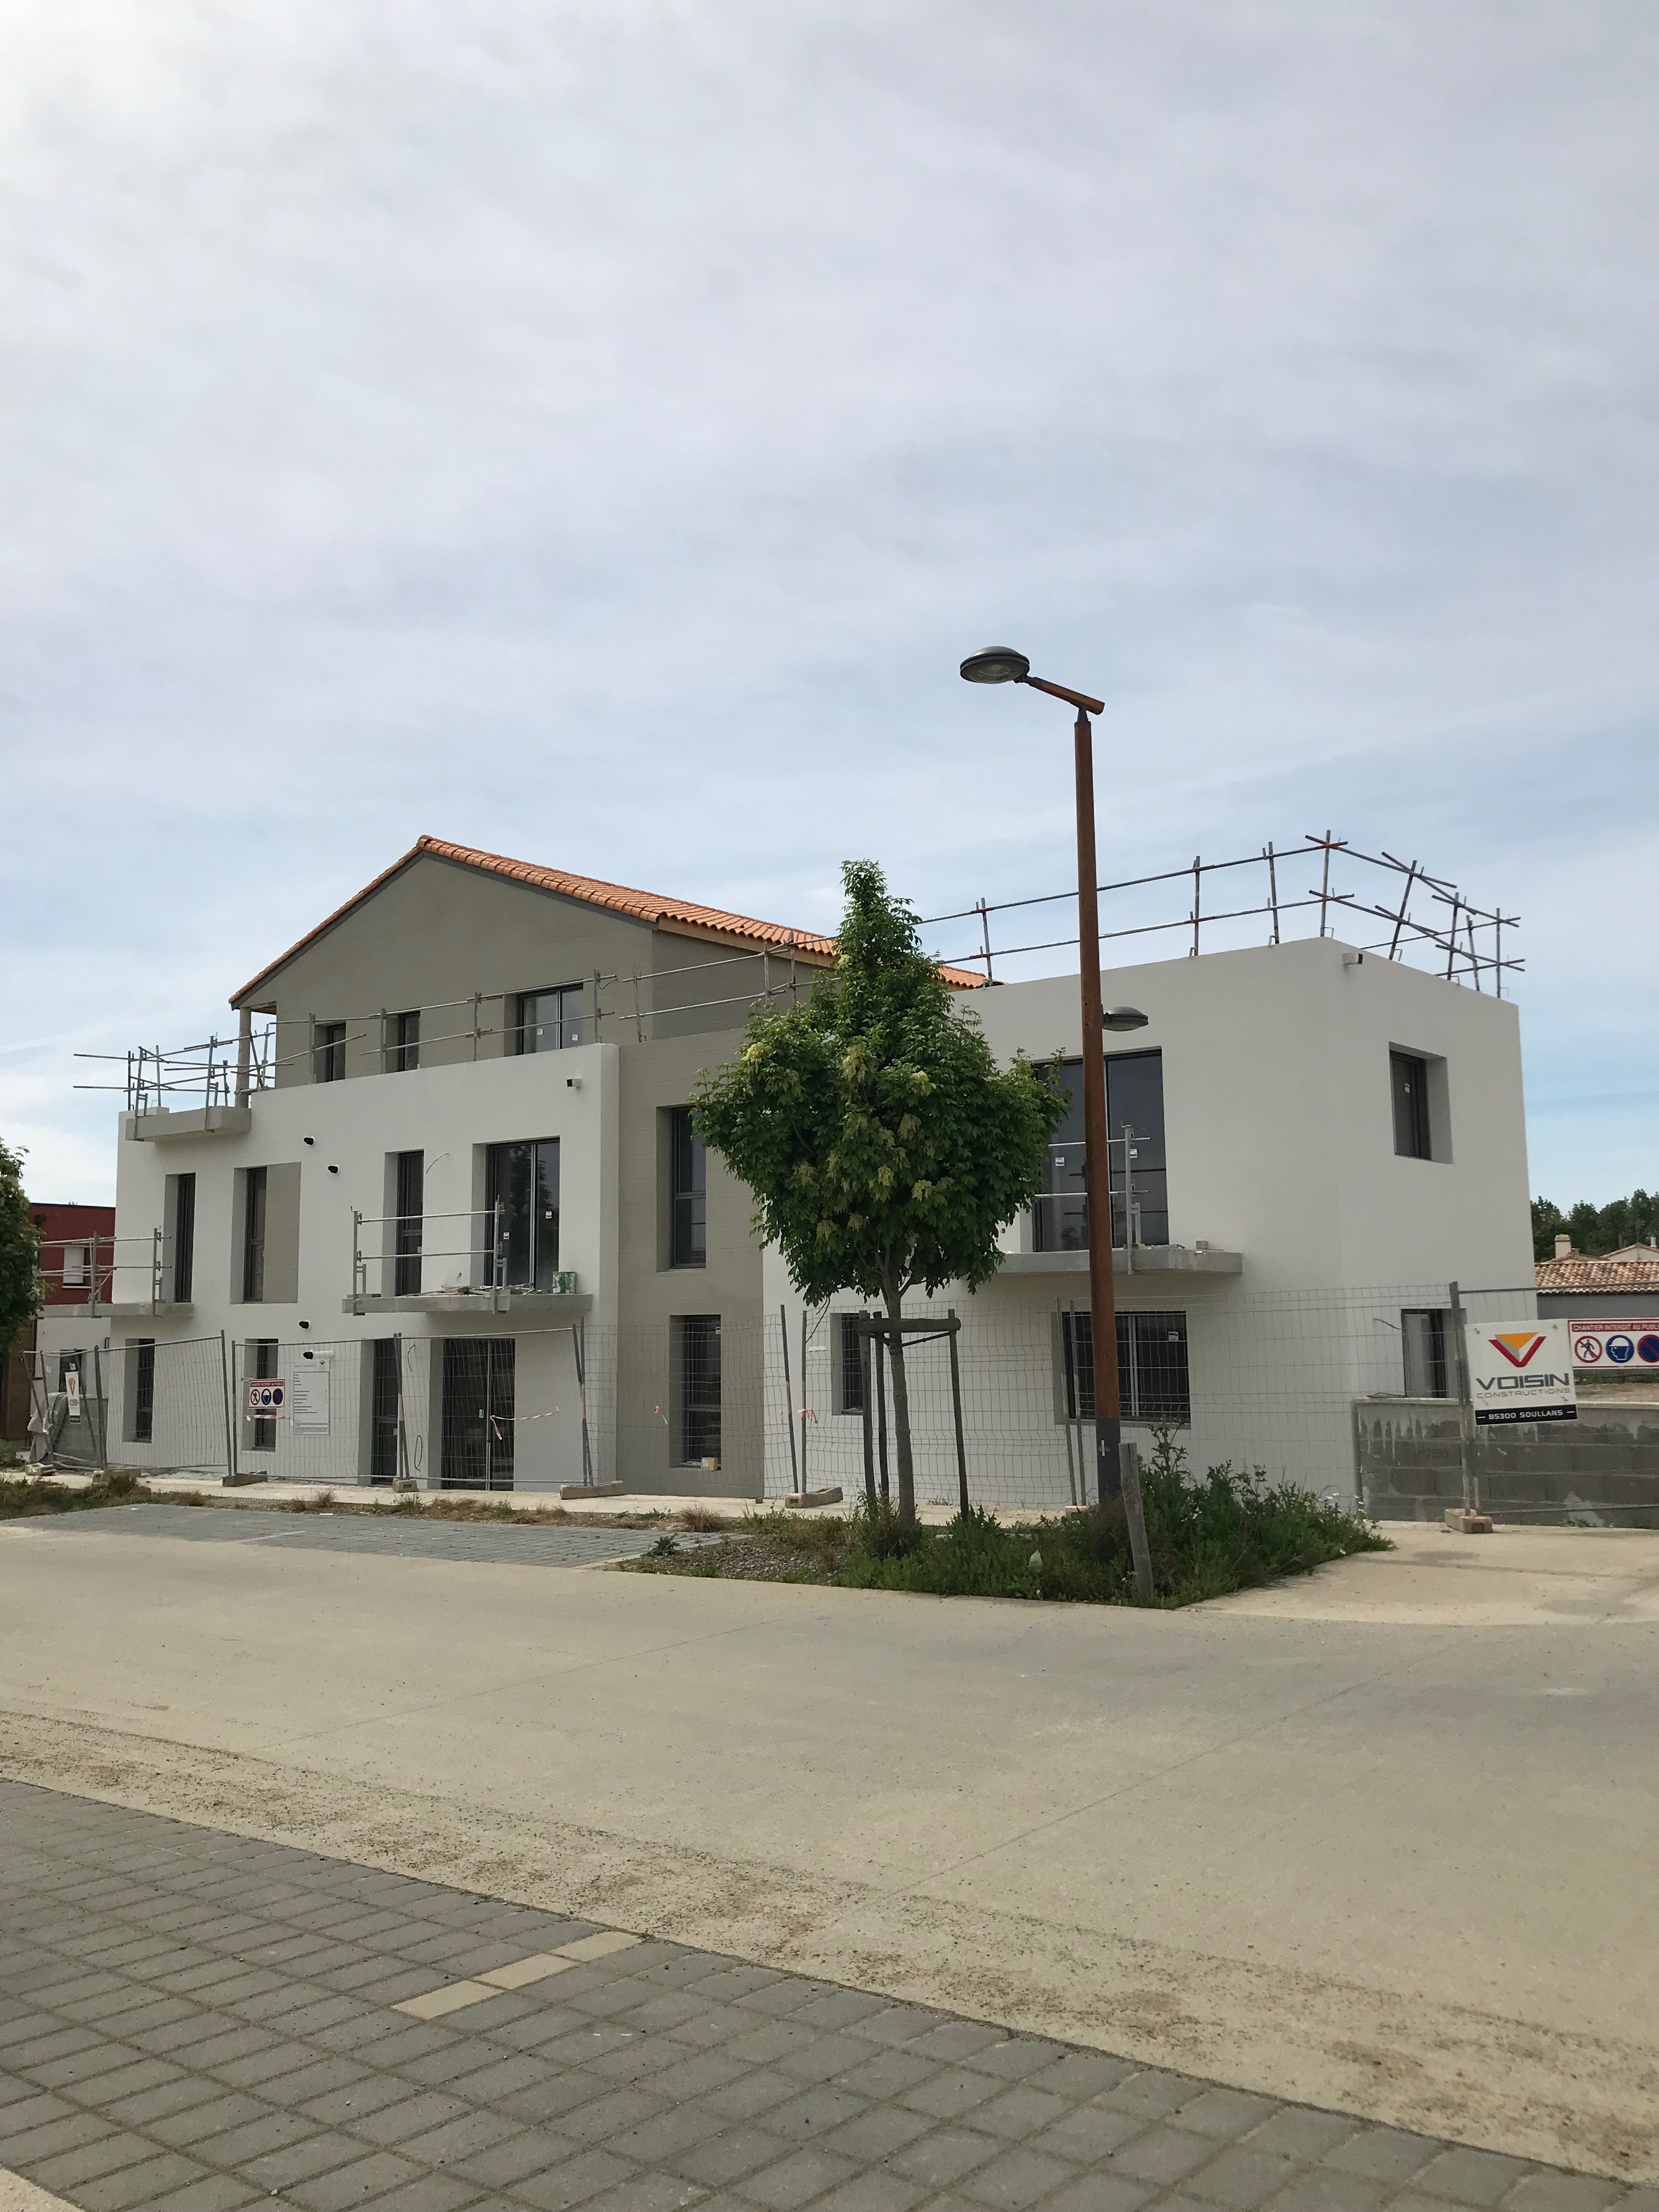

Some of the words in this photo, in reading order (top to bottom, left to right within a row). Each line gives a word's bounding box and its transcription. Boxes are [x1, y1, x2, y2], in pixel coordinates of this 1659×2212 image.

[1476, 1373, 1570, 1391] VOISIN
[1477, 1387, 1571, 1399] CONSTRUCTIONS
[1519, 1409, 1563, 1418] SOULLANS
